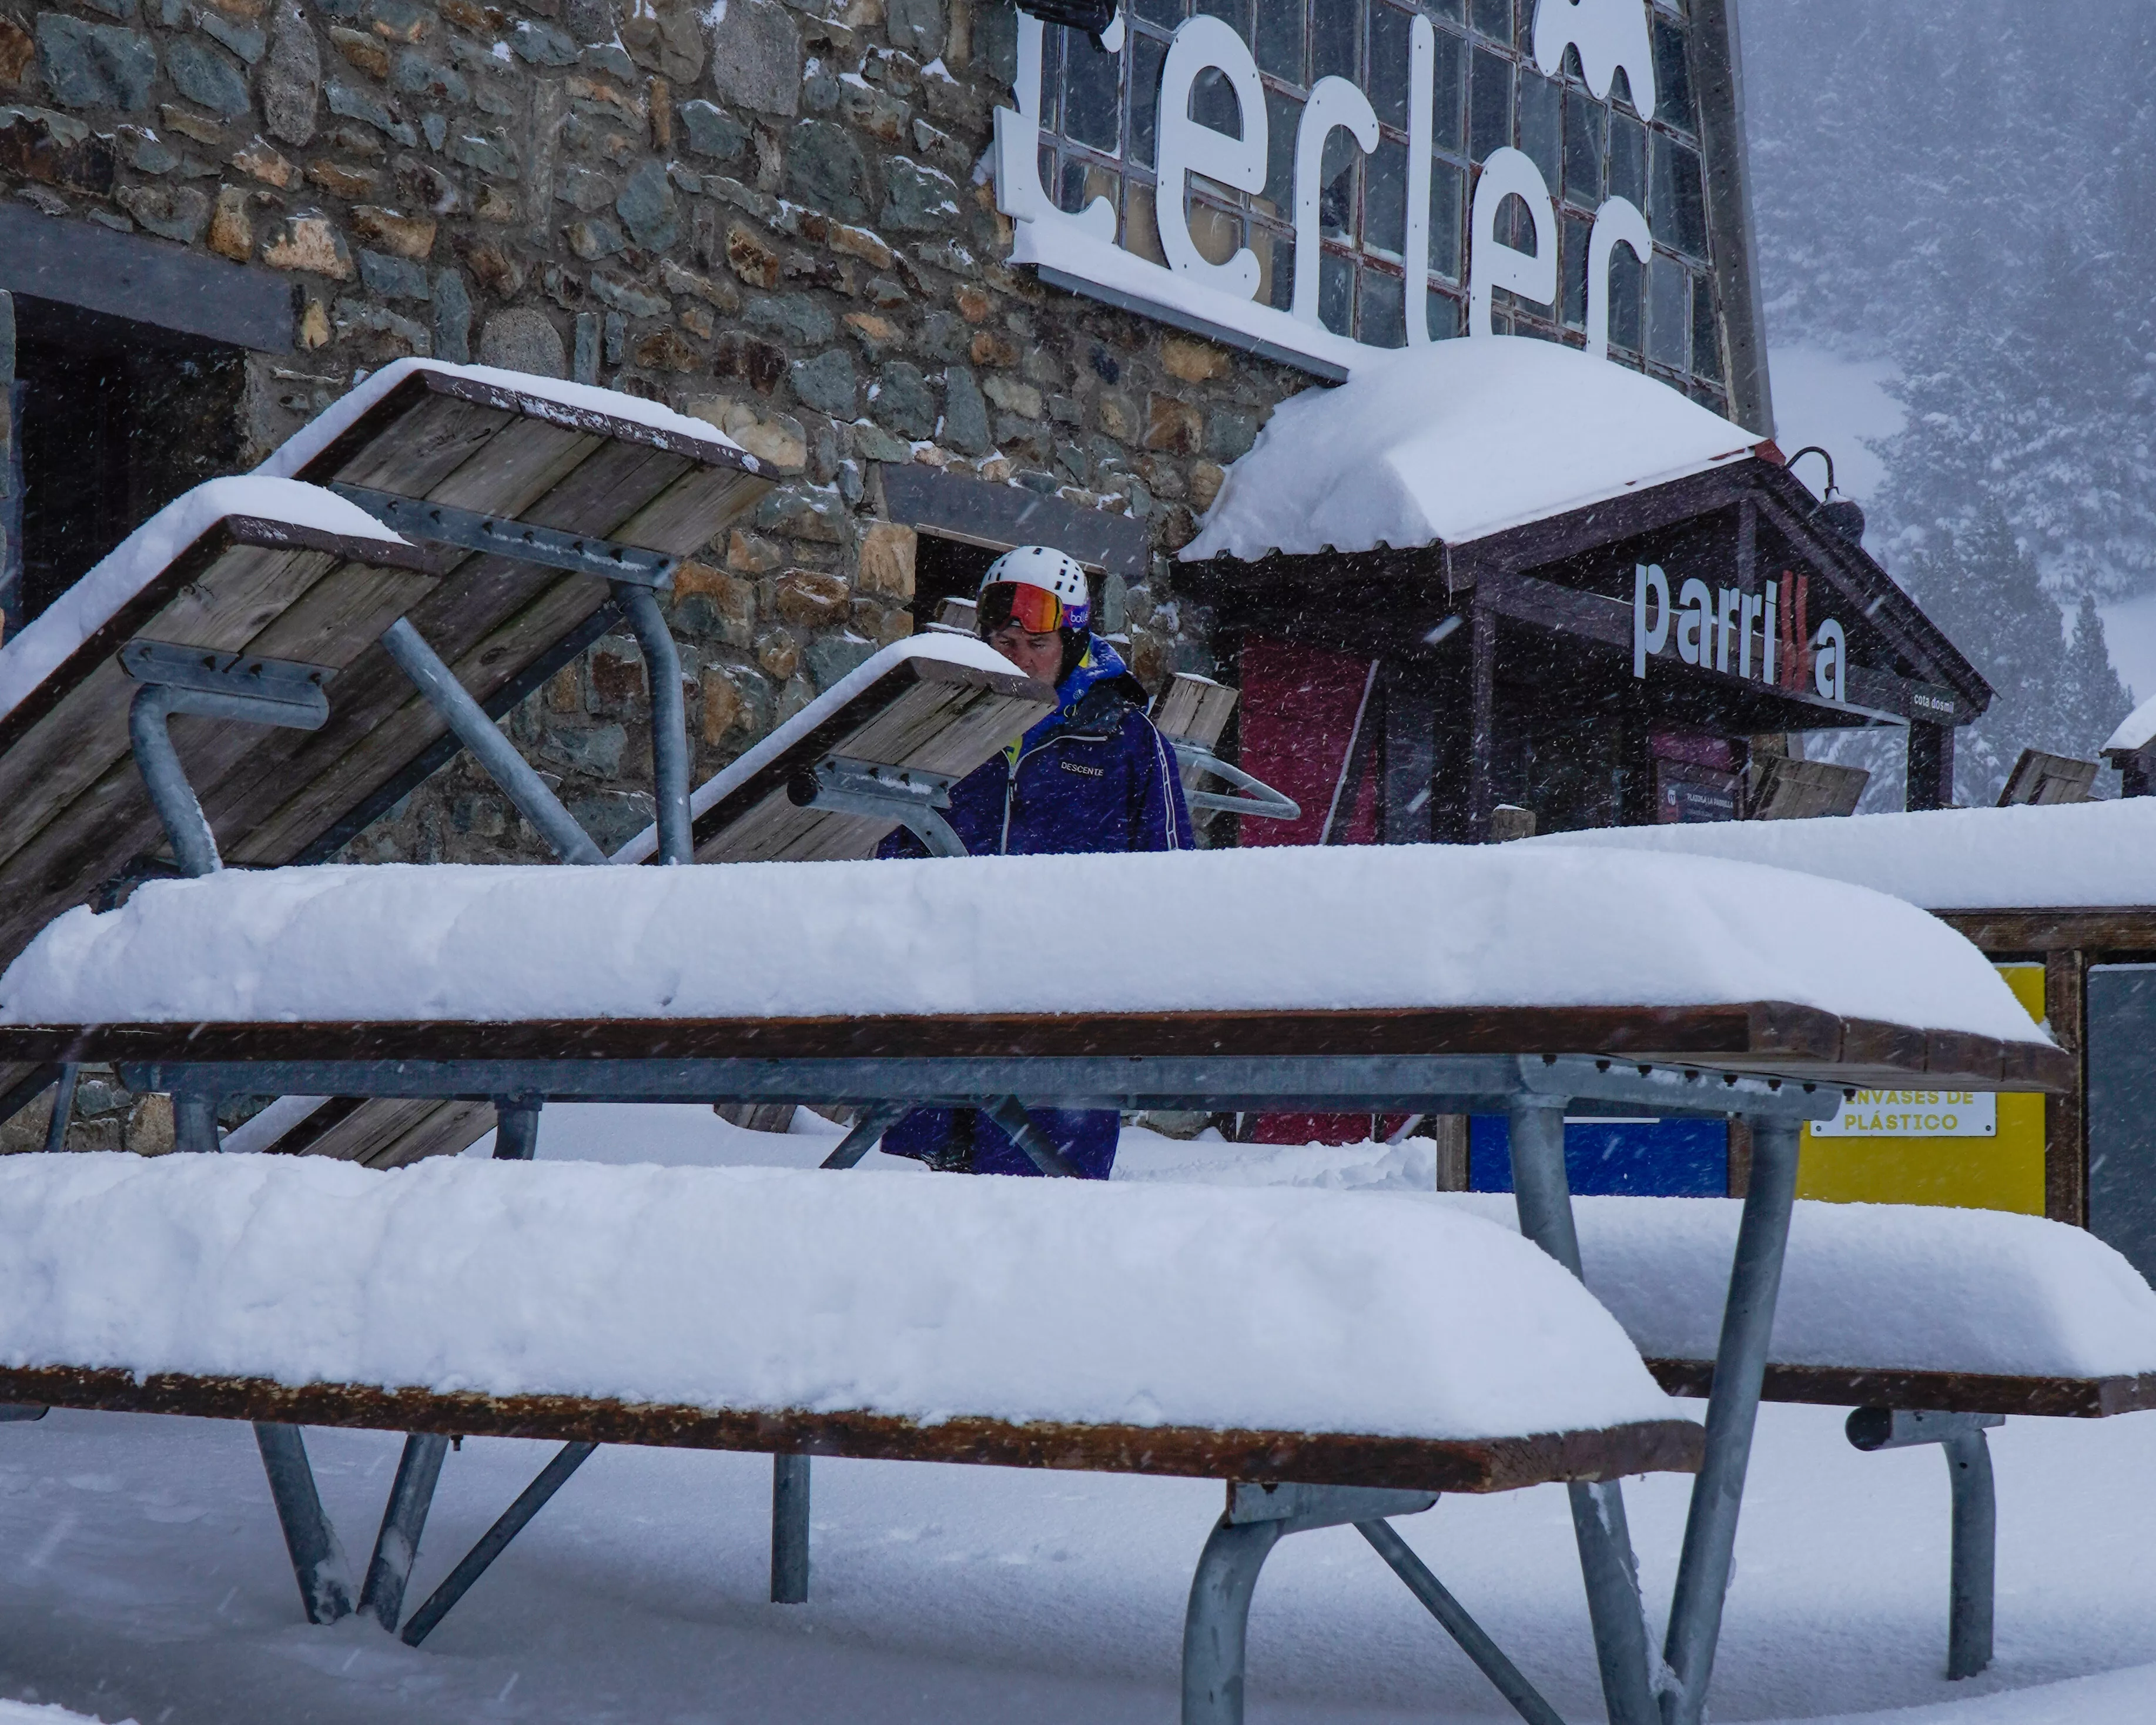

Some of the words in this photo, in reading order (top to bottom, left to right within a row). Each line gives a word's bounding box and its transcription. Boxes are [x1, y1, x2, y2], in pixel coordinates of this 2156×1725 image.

[1633, 563, 1846, 703] parrilla
[1914, 694, 1930, 707] cota
[1061, 761, 1104, 776] DESCENTE
[1946, 1091, 1974, 1104] DE
[1844, 1111, 1958, 1130] PLÁSTICO
